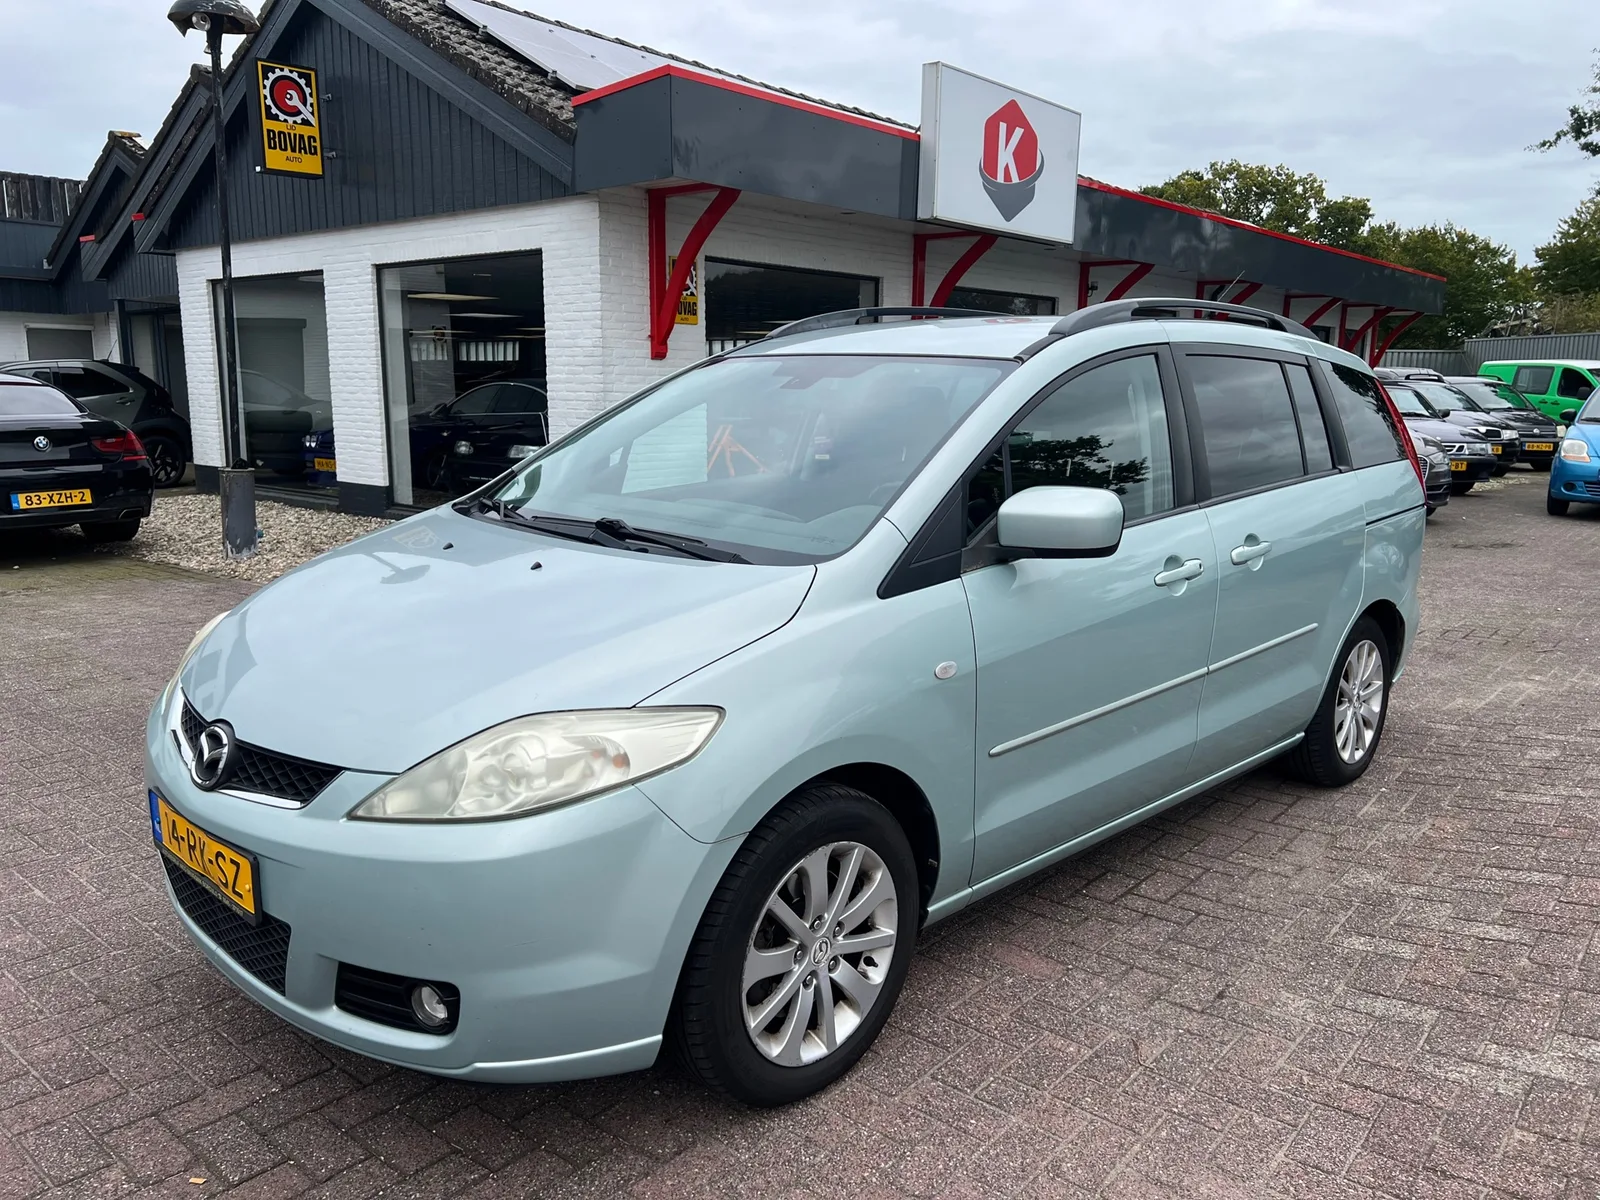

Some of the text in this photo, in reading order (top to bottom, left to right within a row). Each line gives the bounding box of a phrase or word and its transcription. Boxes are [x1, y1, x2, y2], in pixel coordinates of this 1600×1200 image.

[266, 128, 318, 156] BOVAG
[997, 121, 1025, 183] K
[285, 155, 303, 164] AUTO
[677, 301, 697, 316] OVAG
[24, 491, 87, 507] 83-XZH-2
[164, 811, 244, 900] 14-RK-SZ
